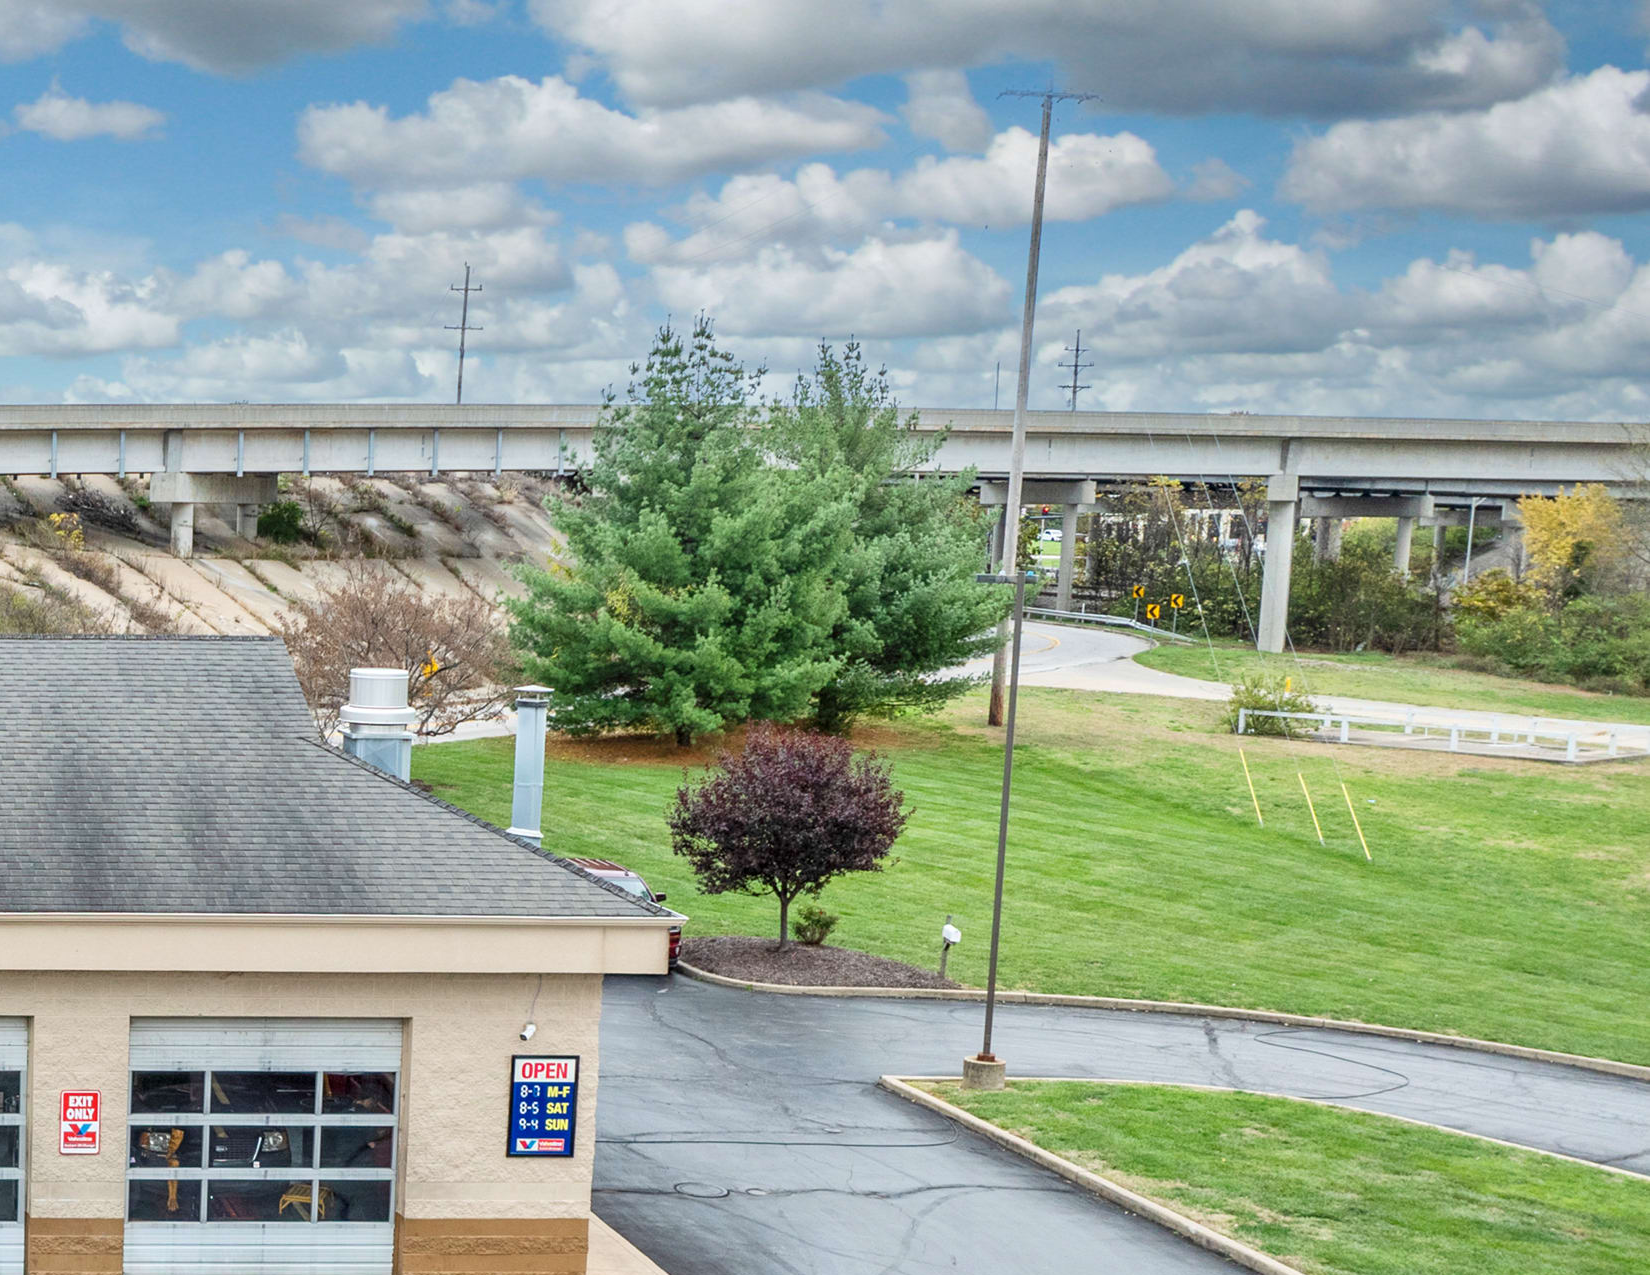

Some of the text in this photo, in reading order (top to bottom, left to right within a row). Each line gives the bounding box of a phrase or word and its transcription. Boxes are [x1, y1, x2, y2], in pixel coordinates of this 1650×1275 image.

[521, 1062, 569, 1079] OPEN
[546, 1085, 571, 1098] M-F
[68, 1095, 94, 1108] EXIT
[66, 1107, 95, 1121] ONLY
[545, 1102, 570, 1115] SAT
[544, 1118, 569, 1131] SUN
